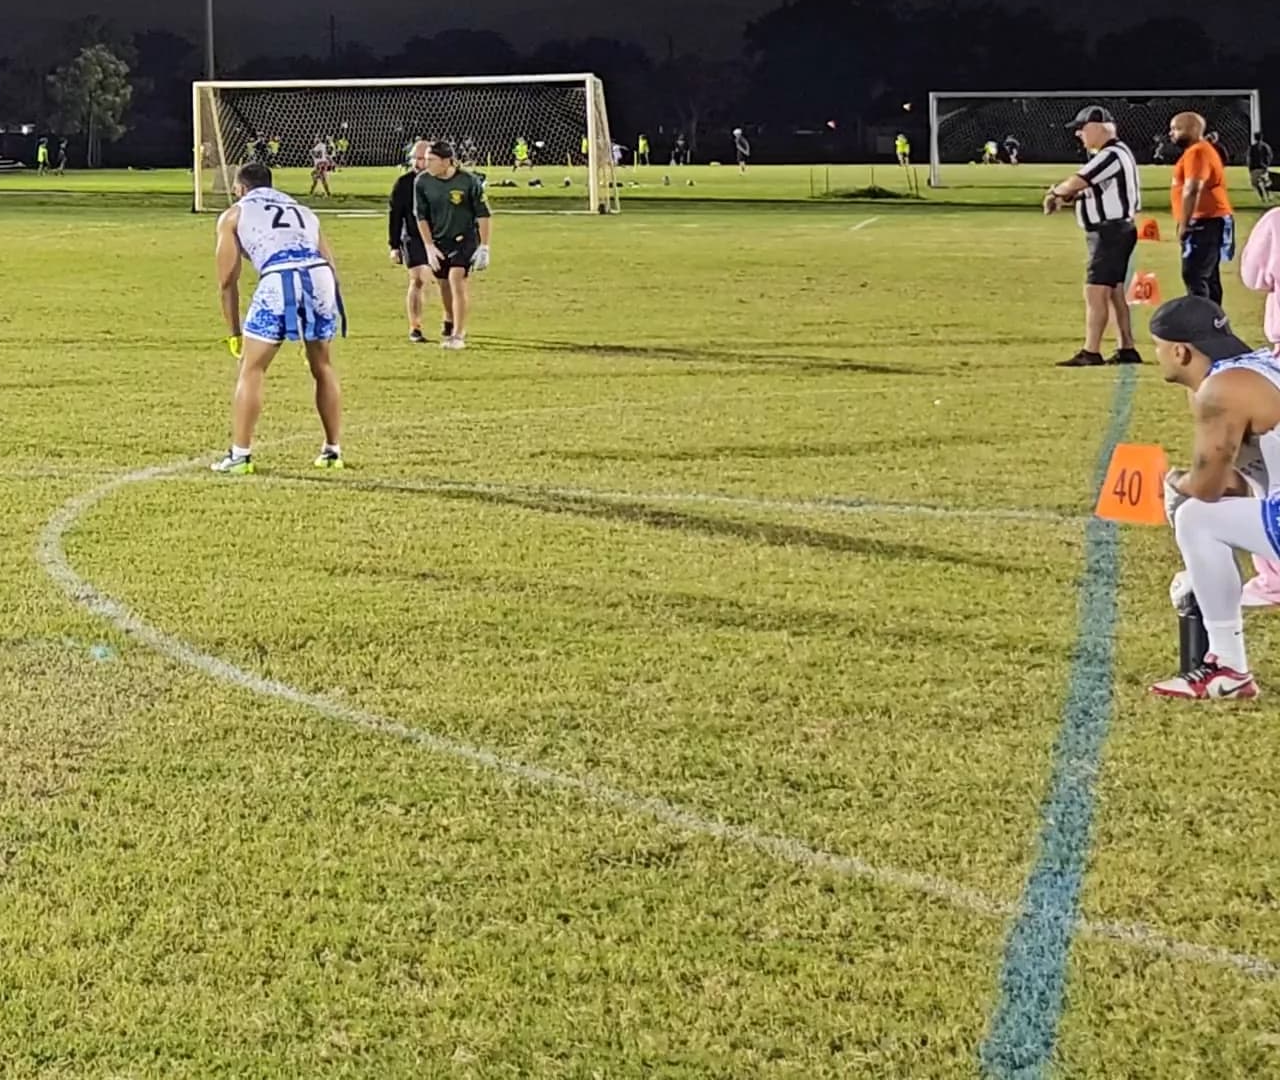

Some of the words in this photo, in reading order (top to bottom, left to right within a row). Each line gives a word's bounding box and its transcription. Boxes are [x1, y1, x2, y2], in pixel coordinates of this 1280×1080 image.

[264, 204, 305, 229] 21
[1134, 282, 1152, 299] 20
[1113, 468, 1142, 506] 40
